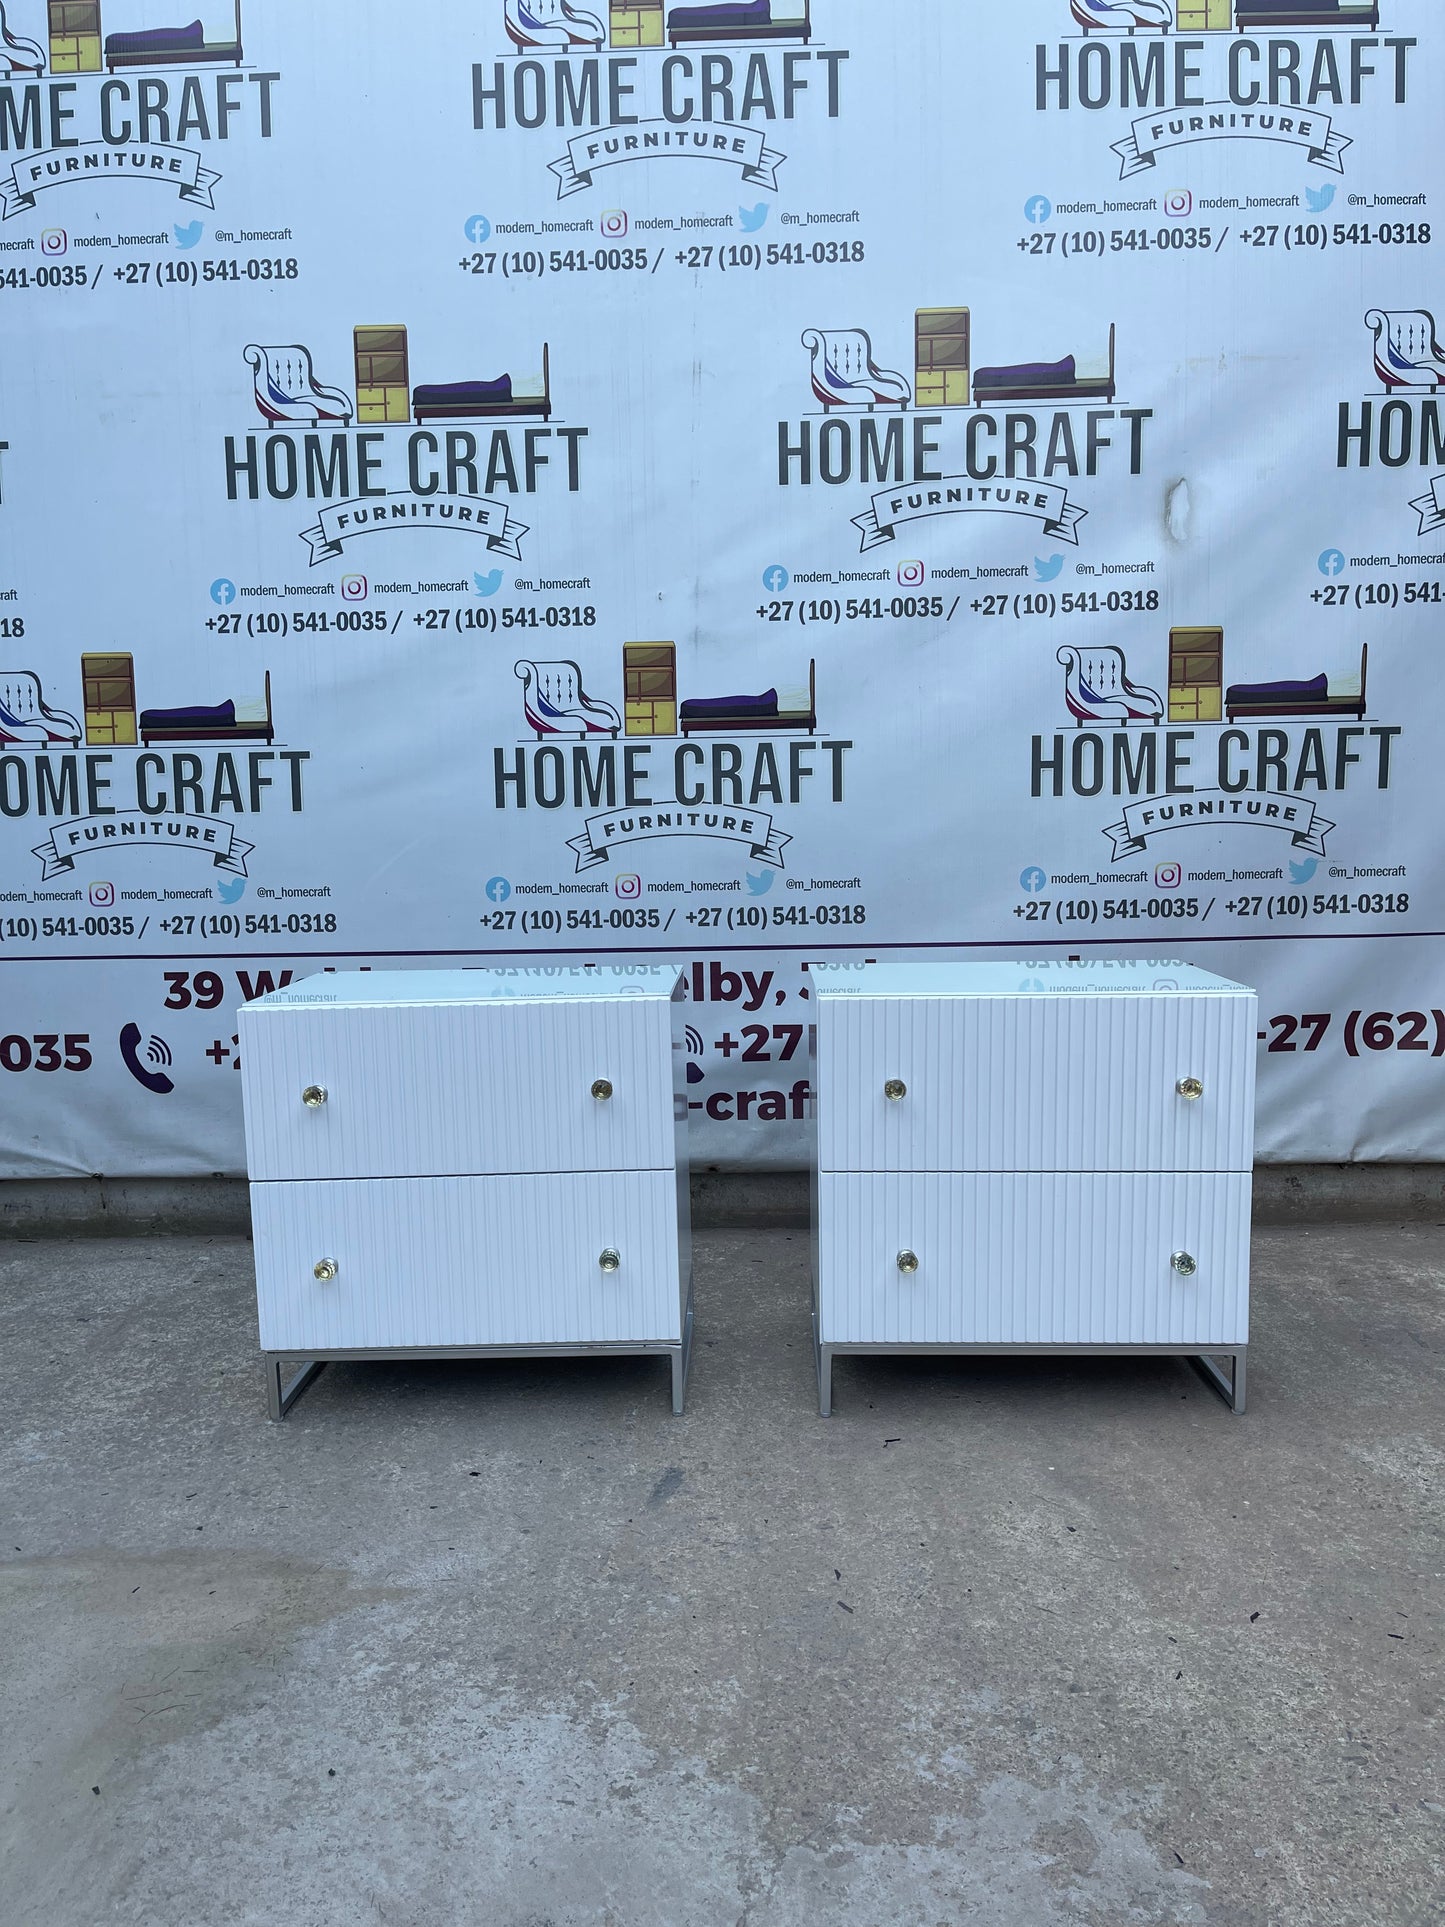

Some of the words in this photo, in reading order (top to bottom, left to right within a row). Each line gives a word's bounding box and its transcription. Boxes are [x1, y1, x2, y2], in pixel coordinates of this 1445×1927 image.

[1036, 41, 1204, 111] HOME
[1229, 37, 1417, 106] CRAFT
[472, 57, 638, 130] HOME
[662, 50, 850, 124] CRAFT
[100, 72, 280, 145] CRAFT
[1151, 114, 1312, 140] FURNITURE
[587, 131, 746, 159] FURNITURE
[30, 153, 182, 181] FURNITURE
[1347, 193, 1427, 208] @m_homecraft
[781, 210, 860, 226] @m_homecraft
[215, 228, 292, 244] @m_homecraft
[1017, 233, 1056, 254] +27
[1061, 231, 1105, 258] (10)
[1110, 227, 1211, 251] 541-0035
[1240, 225, 1279, 247] +27
[1284, 224, 1327, 250] (10)
[1332, 223, 1431, 245] 541-0318
[113, 263, 150, 284] +27
[156, 261, 197, 288] (10)
[202, 258, 298, 281] 541-0318
[459, 253, 497, 274] +27
[502, 251, 544, 278] (10)
[549, 248, 648, 272] 541-0035
[675, 246, 713, 268] +27
[719, 244, 761, 271] (10)
[766, 241, 864, 265] 541-0318
[778, 416, 942, 486] HOME
[966, 408, 1153, 480] CRAFT
[224, 433, 386, 500] HOME
[408, 427, 588, 496] CRAFT
[890, 488, 1048, 514] FURNITURE
[337, 503, 490, 529] FURNITURE
[1076, 561, 1155, 576] @m_homecraft
[514, 577, 591, 592] @m_homecraft
[1310, 585, 1350, 606] +27
[1355, 583, 1398, 609] (10)
[756, 601, 794, 621] +27
[799, 600, 841, 625] (10)
[846, 596, 943, 619] 541-0035
[970, 595, 1008, 615] +27
[1013, 593, 1056, 619] (10)
[1061, 590, 1159, 613] 541-0318
[205, 614, 242, 634] +27
[247, 613, 288, 638] (10)
[292, 611, 387, 632] 541-0035
[413, 609, 450, 629] +27
[455, 608, 497, 633] (10)
[502, 606, 596, 628] 541-0318
[494, 745, 652, 809] HOME
[674, 740, 853, 806] CRAFT
[1031, 731, 1195, 797] HOME
[1218, 726, 1402, 793] CRAFT
[0, 754, 116, 817] OME
[136, 751, 310, 815] CRAFT
[603, 813, 754, 837] FURNITURE
[1142, 800, 1297, 825] FURNITURE
[68, 822, 216, 846] FURNITURE
[786, 877, 861, 891] @m_homecraft
[1328, 865, 1406, 879] @m_homecraft
[257, 886, 331, 900] @m_homecraft
[480, 911, 516, 930] +27
[521, 910, 562, 934] (10)
[566, 909, 660, 929] 541-0035
[685, 908, 722, 927] +27
[727, 907, 767, 931] (10)
[772, 905, 866, 926] 541-0318
[1013, 901, 1051, 921] +27
[1056, 900, 1098, 924] (10)
[1103, 898, 1199, 919] 541-0035
[1225, 896, 1263, 916] +27
[1267, 895, 1308, 920] (10)
[1312, 893, 1409, 914] 541-0318
[42, 916, 134, 936] 541-0035
[160, 916, 195, 935] +27
[200, 915, 240, 939] (10)
[245, 913, 337, 934] 541-0318
[164, 971, 224, 1010] 39
[714, 1024, 803, 1062] +27
[1257, 1013, 1331, 1053] 27
[1344, 1009, 1445, 1057] (62)
